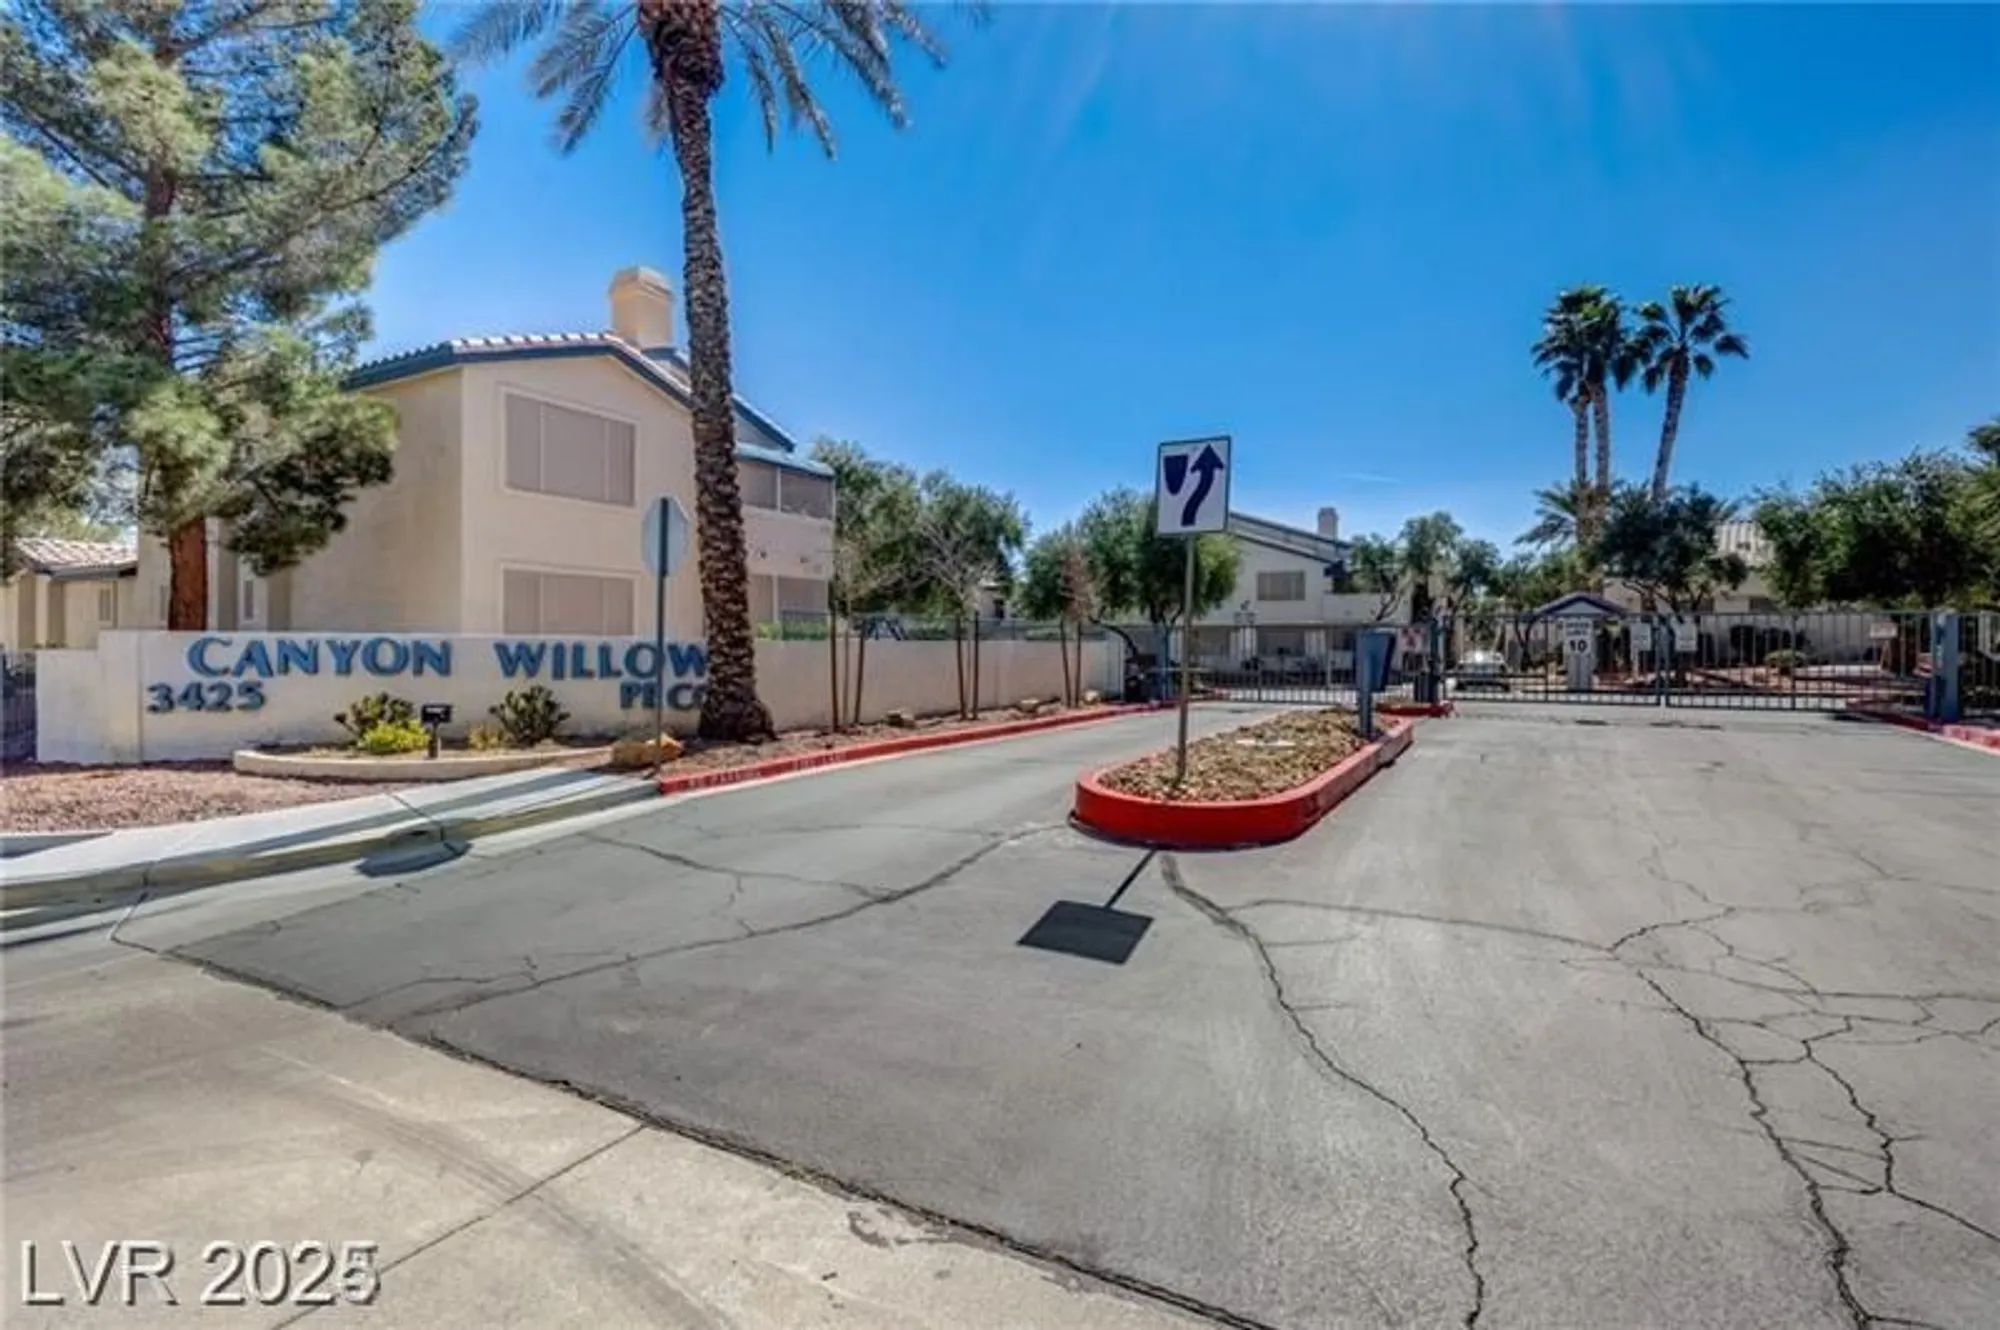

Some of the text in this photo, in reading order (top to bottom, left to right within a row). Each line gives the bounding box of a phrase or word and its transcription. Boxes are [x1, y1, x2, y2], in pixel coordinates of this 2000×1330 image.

[187, 637, 708, 680] CANYON WILLOW
[1570, 639, 1588, 653] 10
[147, 681, 267, 713] 3425
